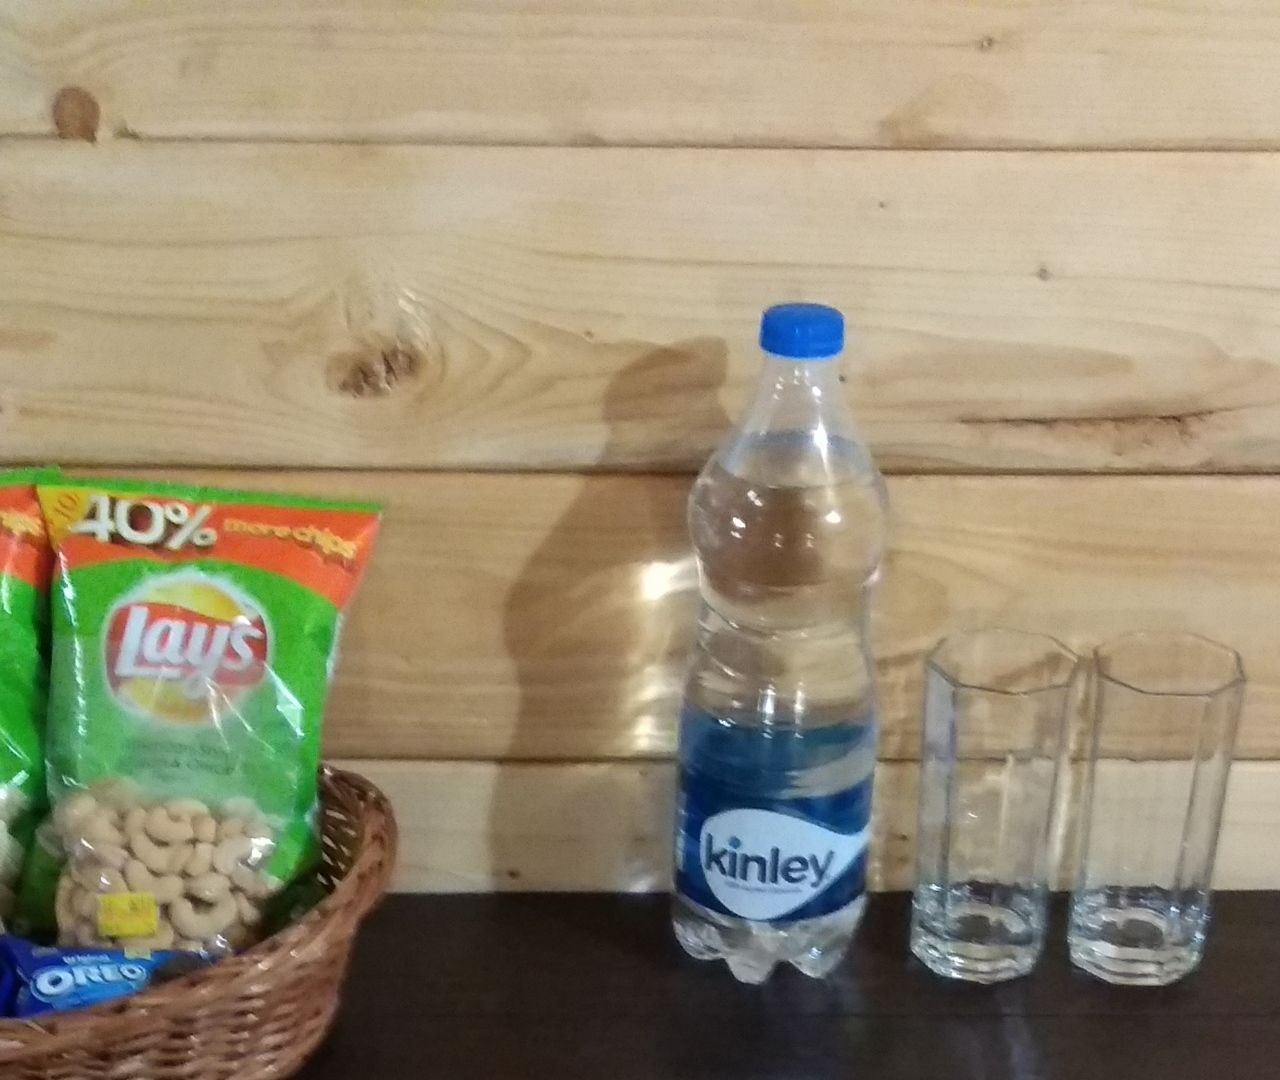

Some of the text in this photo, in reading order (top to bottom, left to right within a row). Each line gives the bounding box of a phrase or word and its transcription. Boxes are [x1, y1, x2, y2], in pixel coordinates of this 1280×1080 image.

[69, 494, 217, 551] 40%
[705, 832, 835, 888] kinley
[35, 963, 147, 996] OREO
